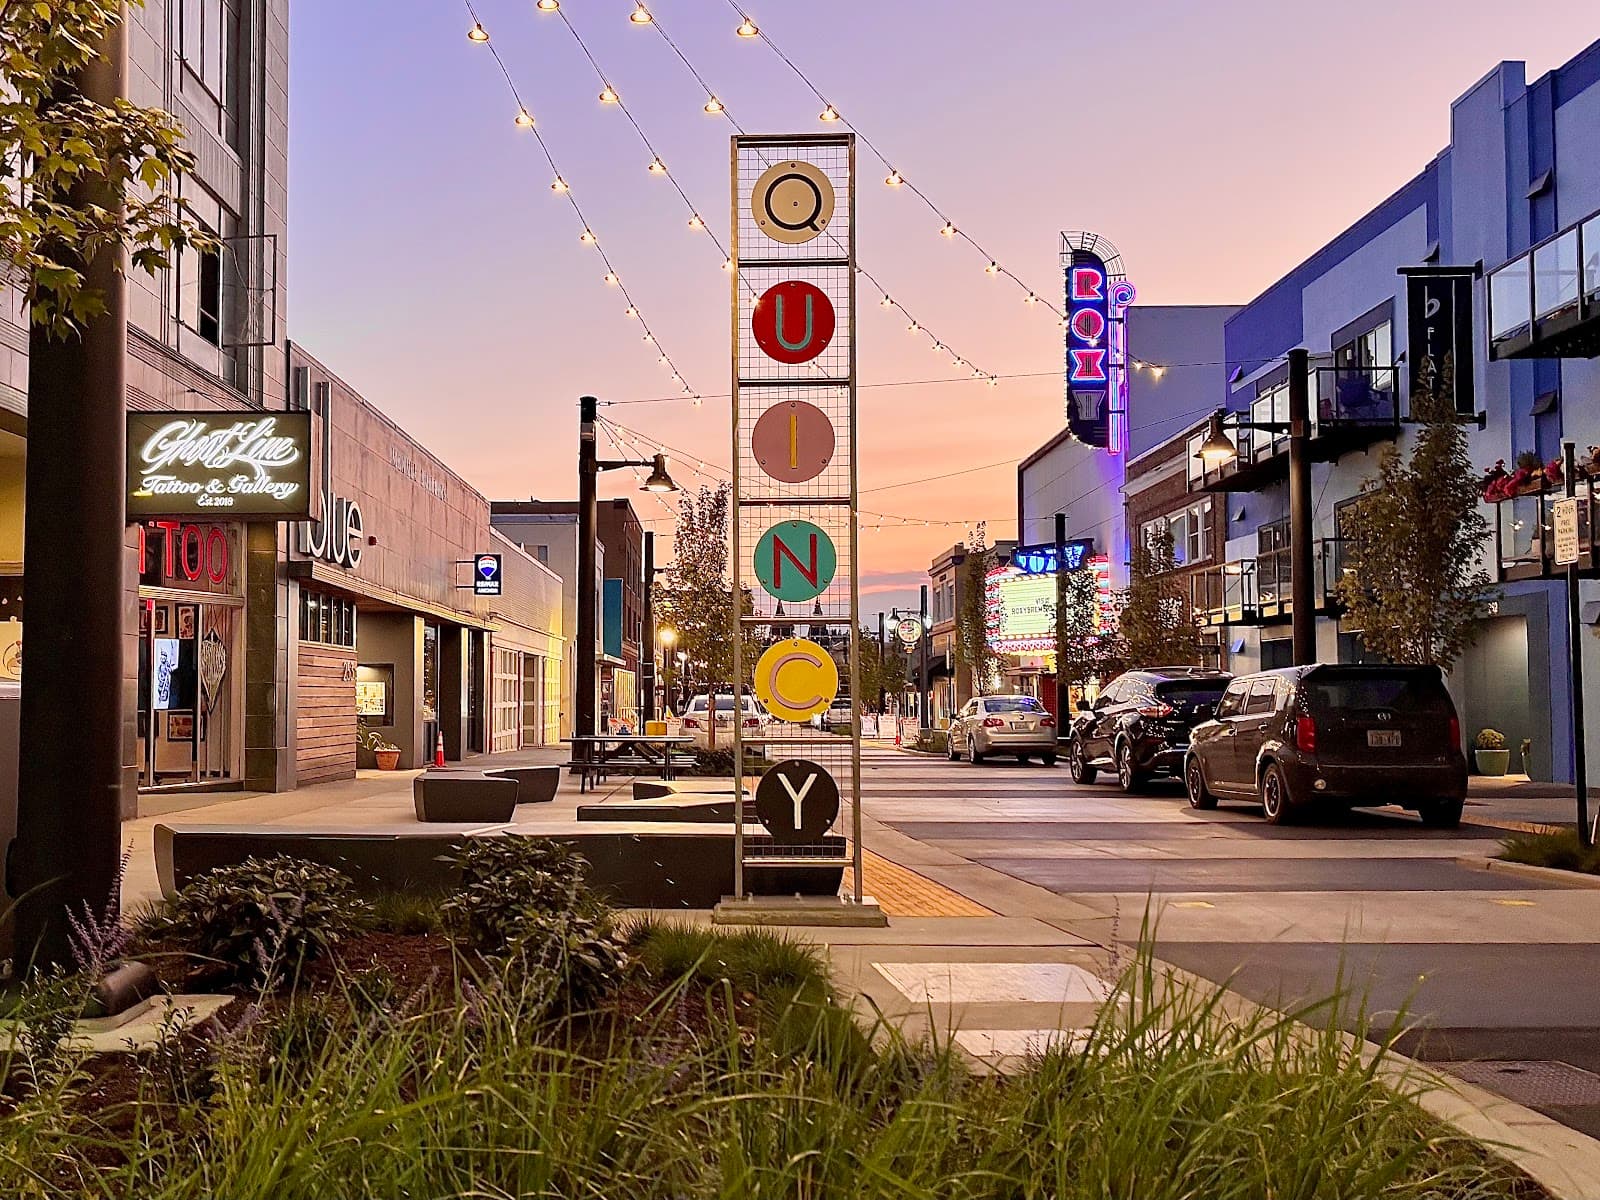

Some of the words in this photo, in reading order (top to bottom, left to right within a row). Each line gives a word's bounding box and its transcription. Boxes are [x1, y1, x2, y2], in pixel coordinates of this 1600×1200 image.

[1071, 267, 1107, 421] ROXY
[230, 417, 299, 468] Line
[140, 475, 204, 494] Tattoo
[205, 478, 226, 494] &
[228, 474, 299, 500] Gallery
